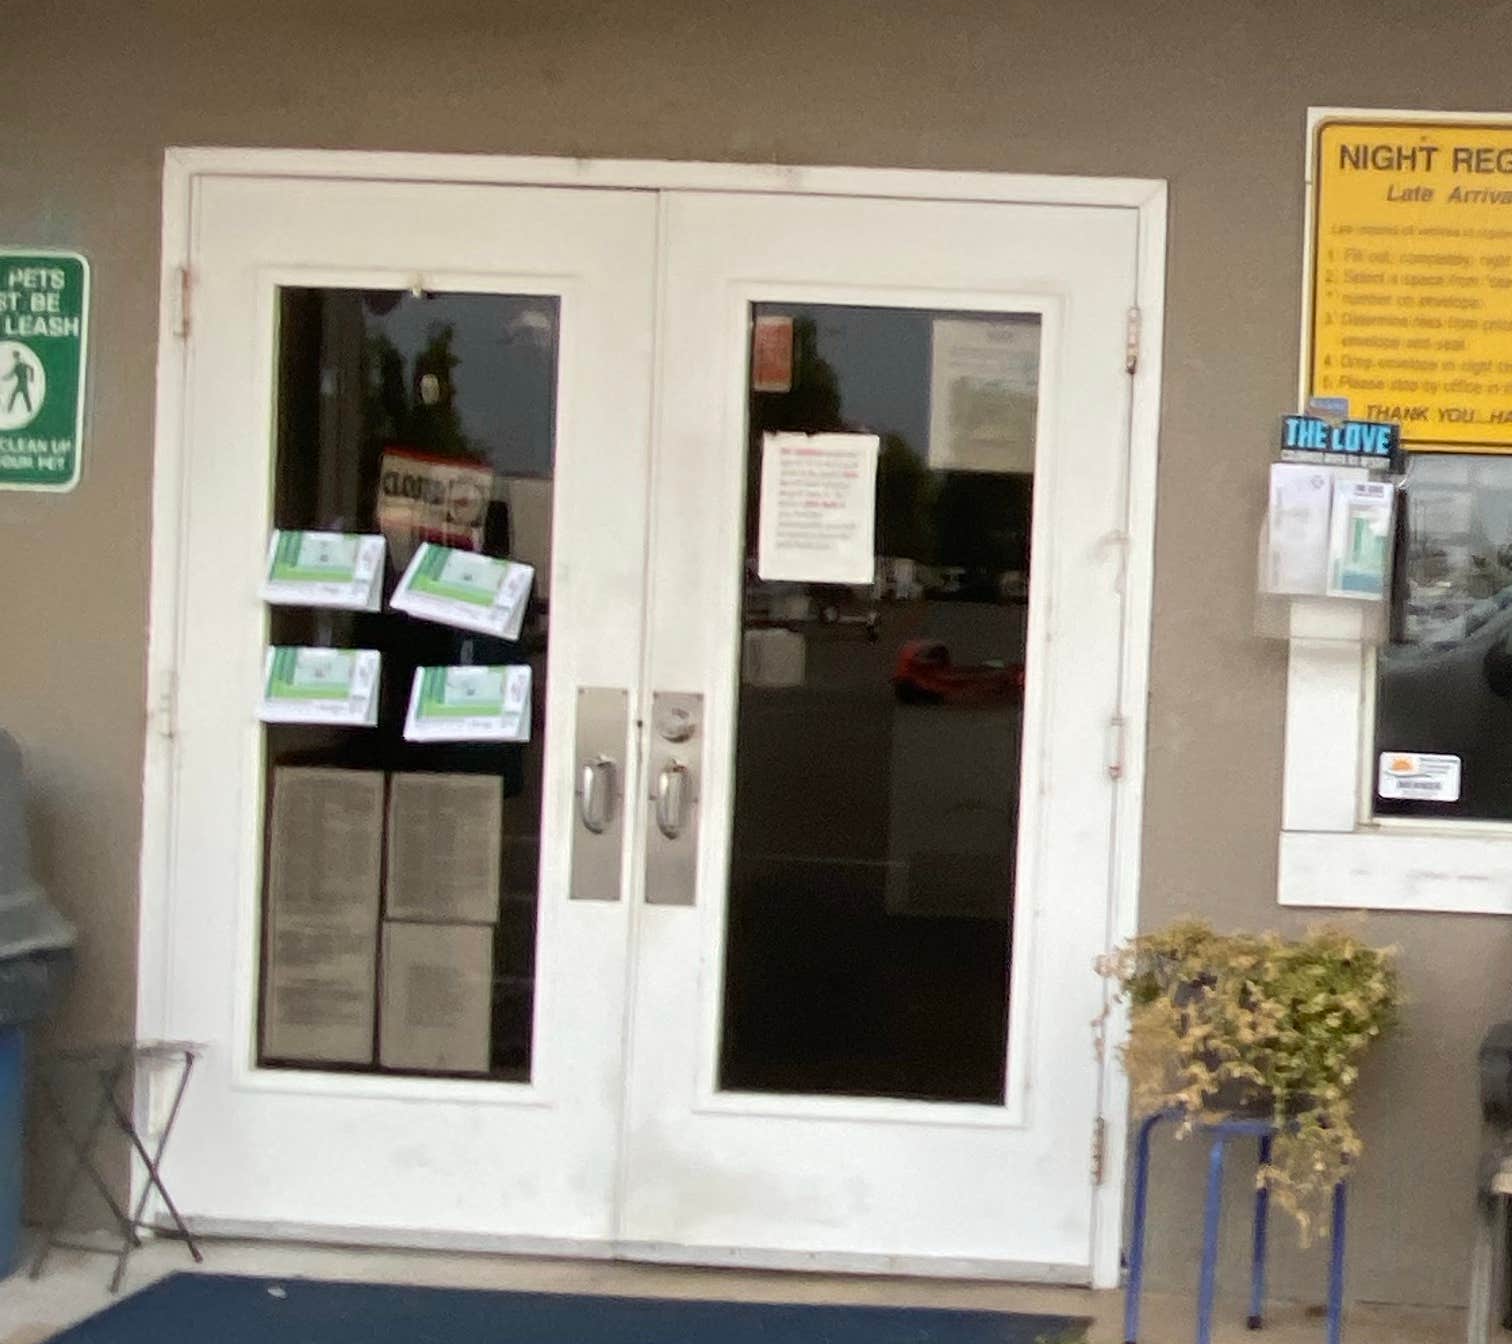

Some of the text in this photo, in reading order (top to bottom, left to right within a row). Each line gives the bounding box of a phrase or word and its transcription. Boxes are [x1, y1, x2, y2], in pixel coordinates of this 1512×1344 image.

[1339, 145, 1438, 172] NIGHT
[1387, 184, 1434, 204] Late
[8, 268, 65, 289] PETS
[30, 292, 61, 313] BE
[5, 316, 79, 337] LEASH
[1366, 404, 1429, 423] THANK
[1285, 418, 1390, 454] THE LOVE
